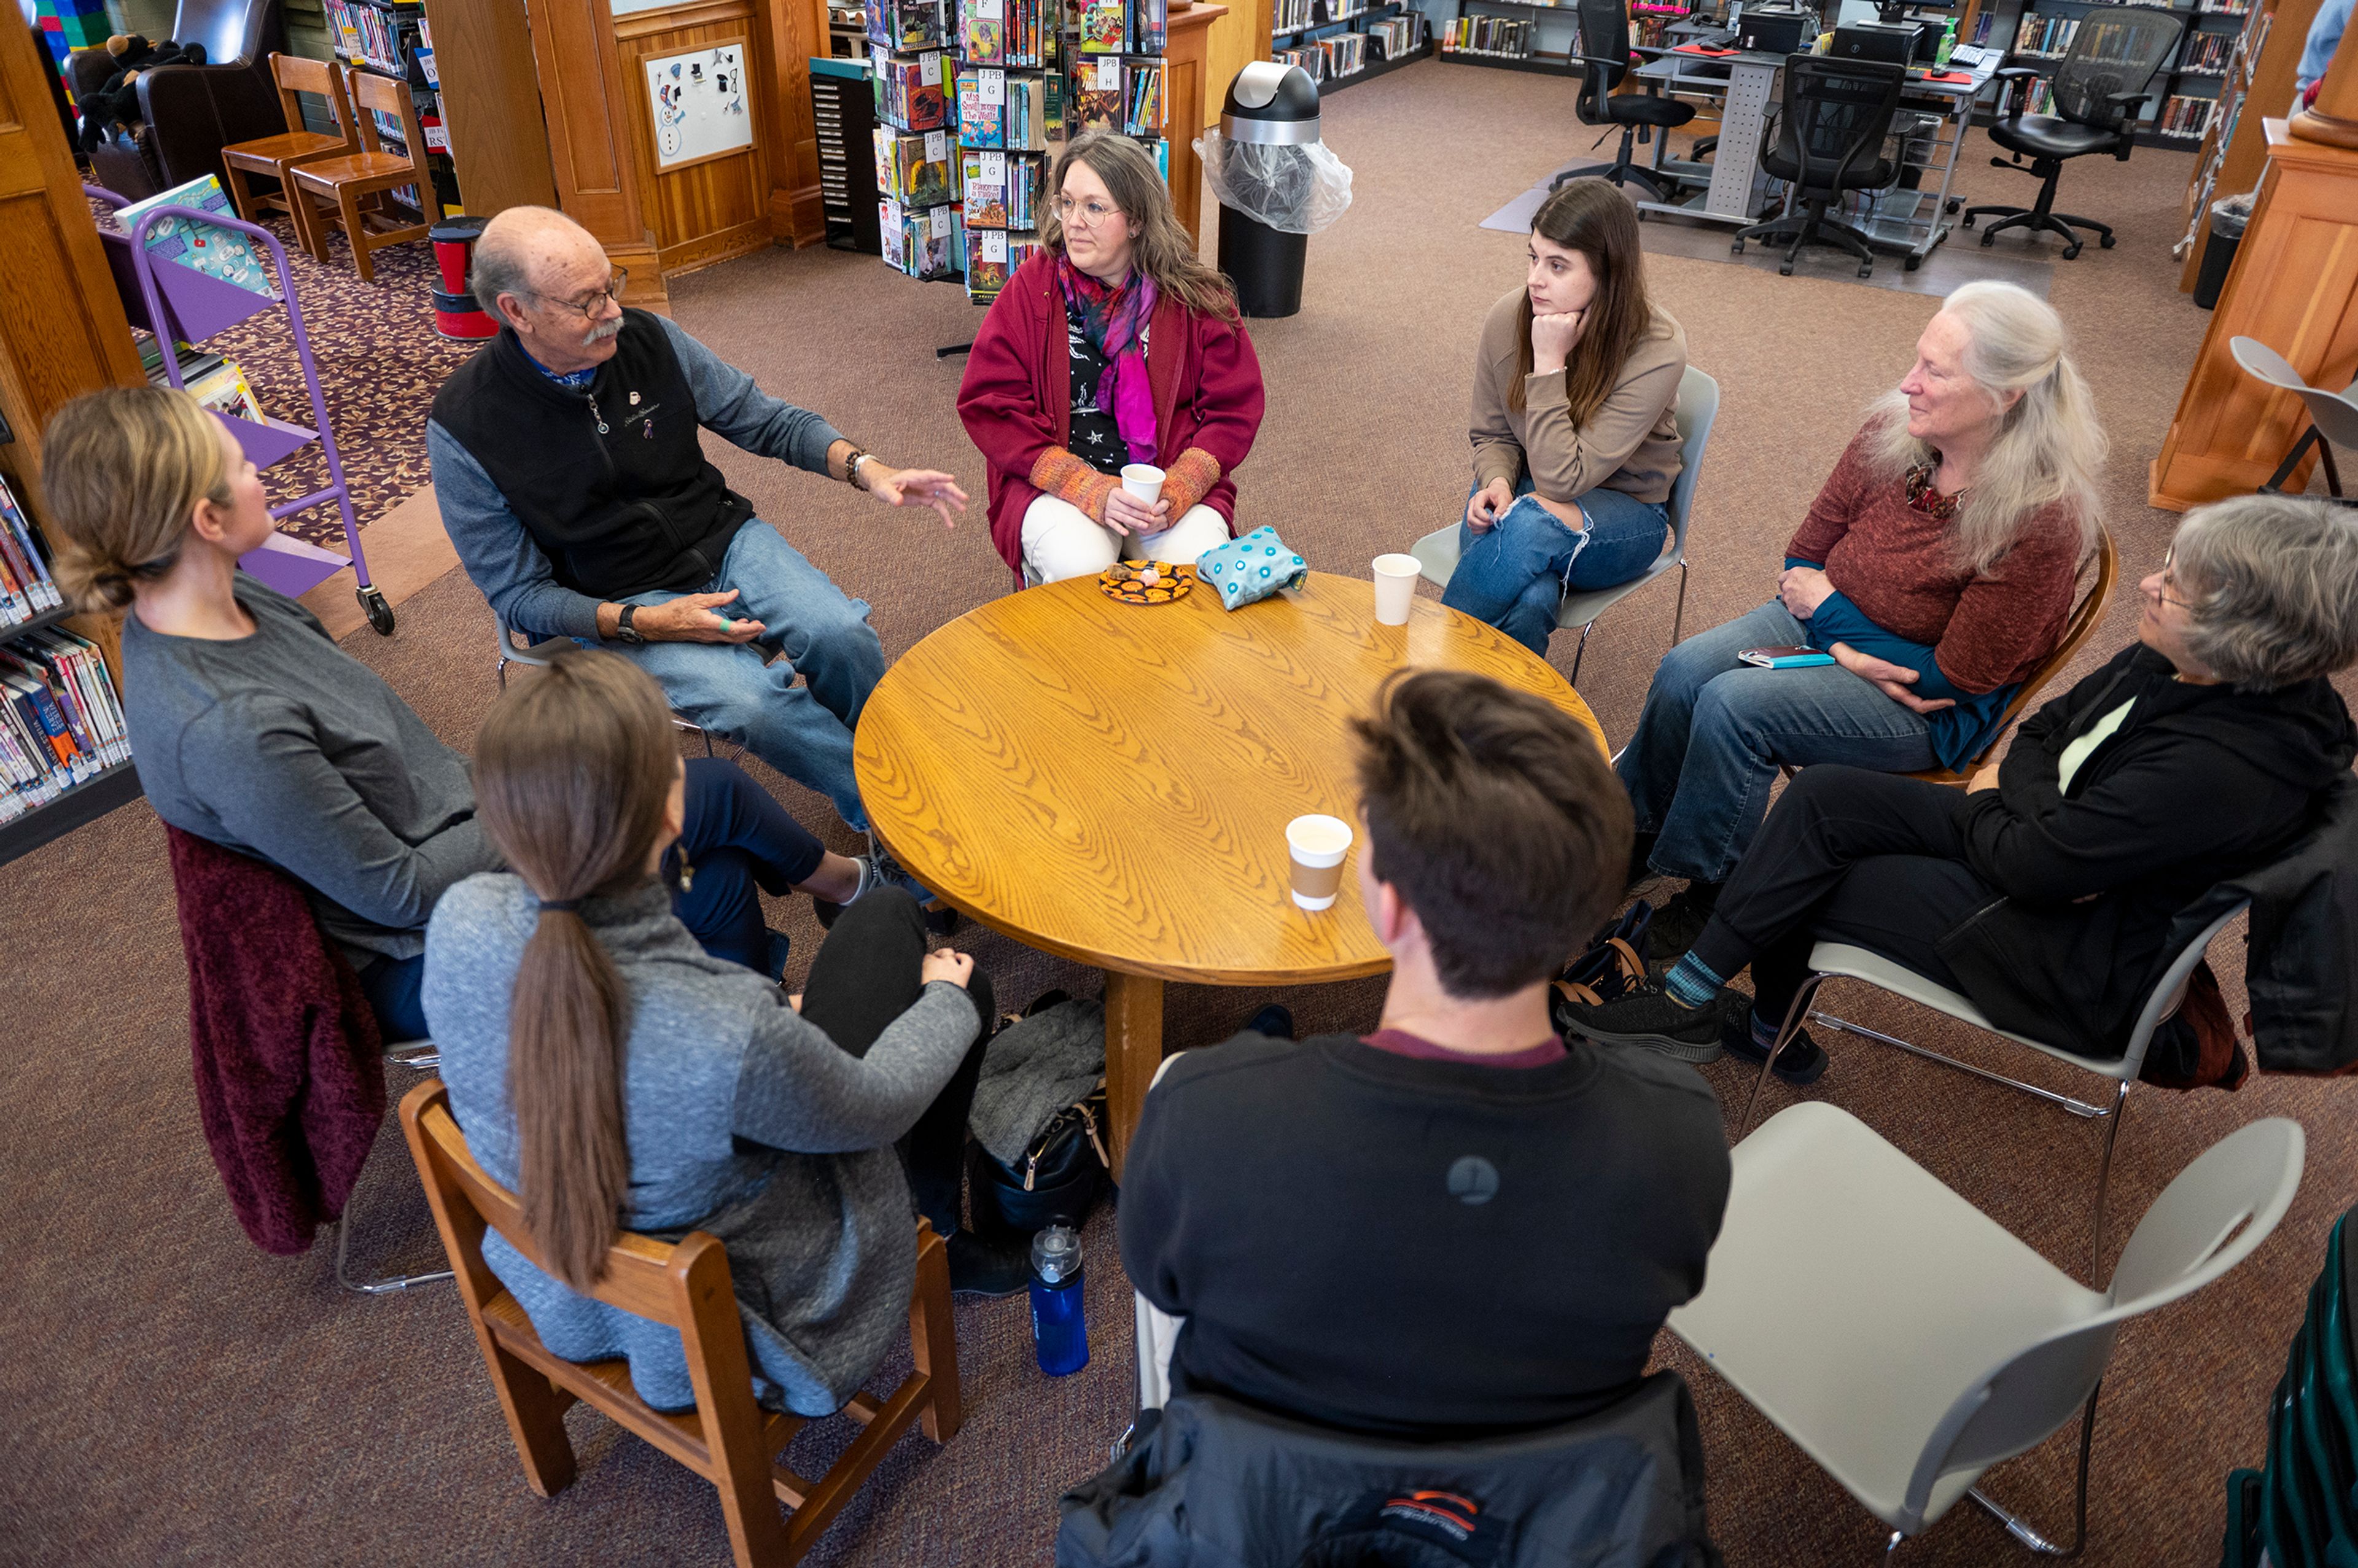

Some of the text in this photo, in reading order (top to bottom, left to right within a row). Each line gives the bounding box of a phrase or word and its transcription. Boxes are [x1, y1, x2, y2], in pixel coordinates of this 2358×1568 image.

[928, 52, 938, 61] PB
[426, 68, 437, 78] O
[928, 67, 934, 76] C
[981, 70, 1002, 79] J PB
[987, 85, 995, 95] G
[962, 100, 978, 111] Small
[886, 126, 894, 135] PB
[429, 136, 445, 146] RS
[926, 133, 942, 144] J PB
[932, 147, 938, 156] C
[982, 152, 1002, 161] J PB
[988, 167, 995, 176] G
[892, 201, 900, 211] PB
[937, 207, 947, 215] PB
[938, 220, 943, 229] C
[991, 231, 1004, 239] PB
[42, 705, 58, 732] NERVE
[49, 702, 64, 729] WIRES
[33, 719, 49, 744] WIRES
